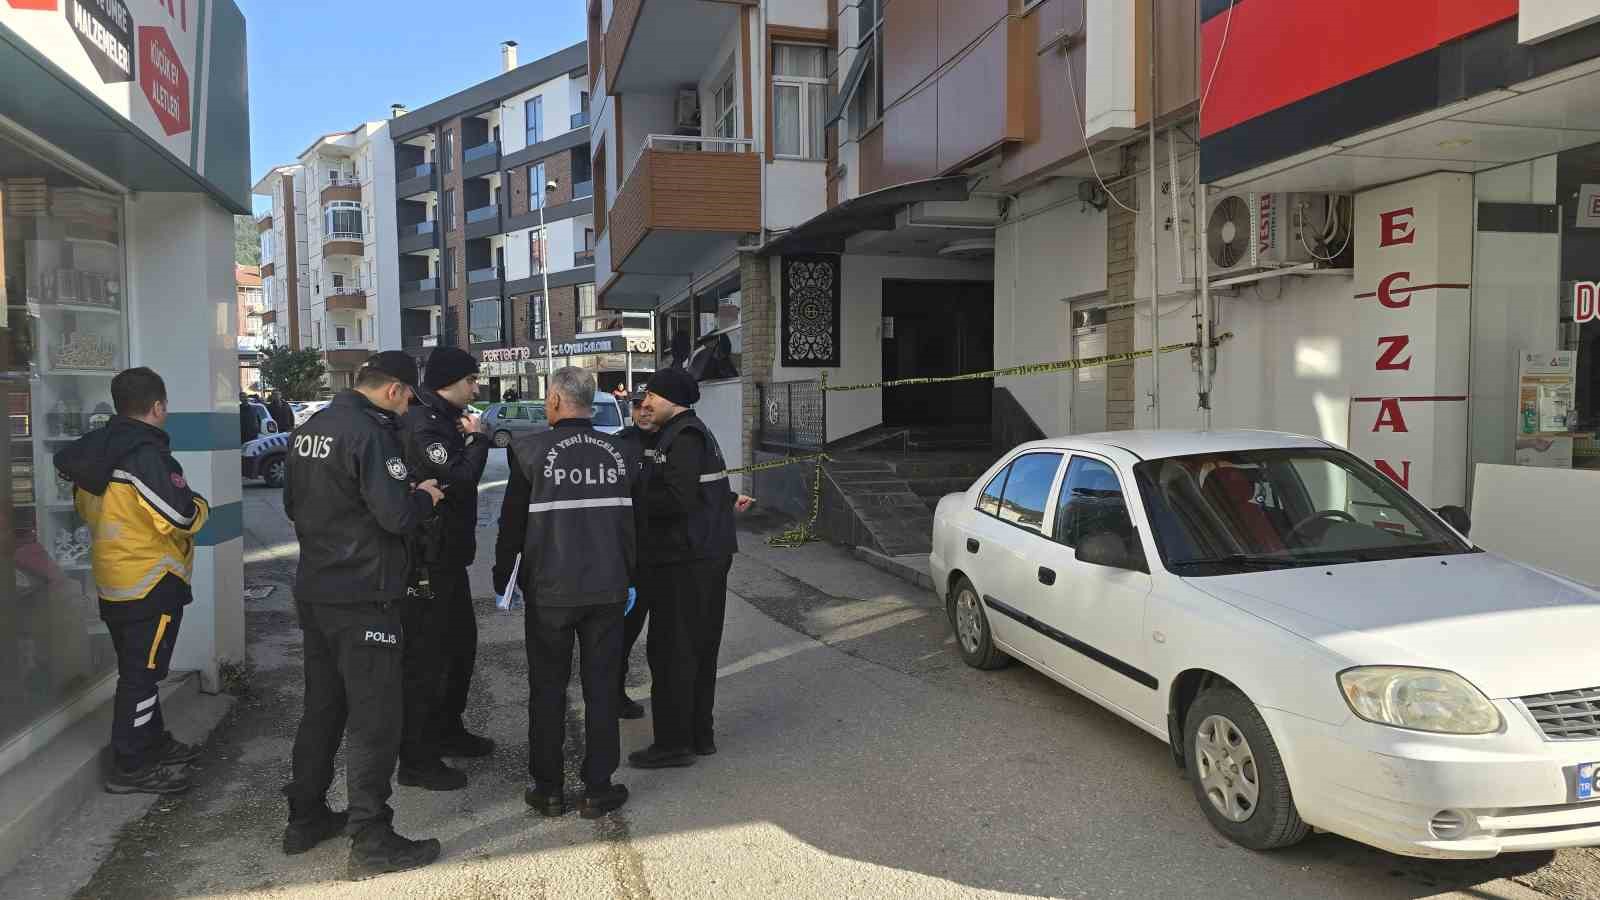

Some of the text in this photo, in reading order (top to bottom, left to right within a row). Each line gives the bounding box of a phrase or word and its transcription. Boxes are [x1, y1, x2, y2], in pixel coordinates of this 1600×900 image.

[73, 0, 130, 76] MALZEMELERİ
[150, 39, 179, 87] KÜÇÜK EV
[152, 80, 180, 121] ALETLERİ
[1574, 281, 1600, 323] D
[543, 433, 626, 478] OLAY YERİ İNCELEME
[554, 463, 619, 485] POLİS
